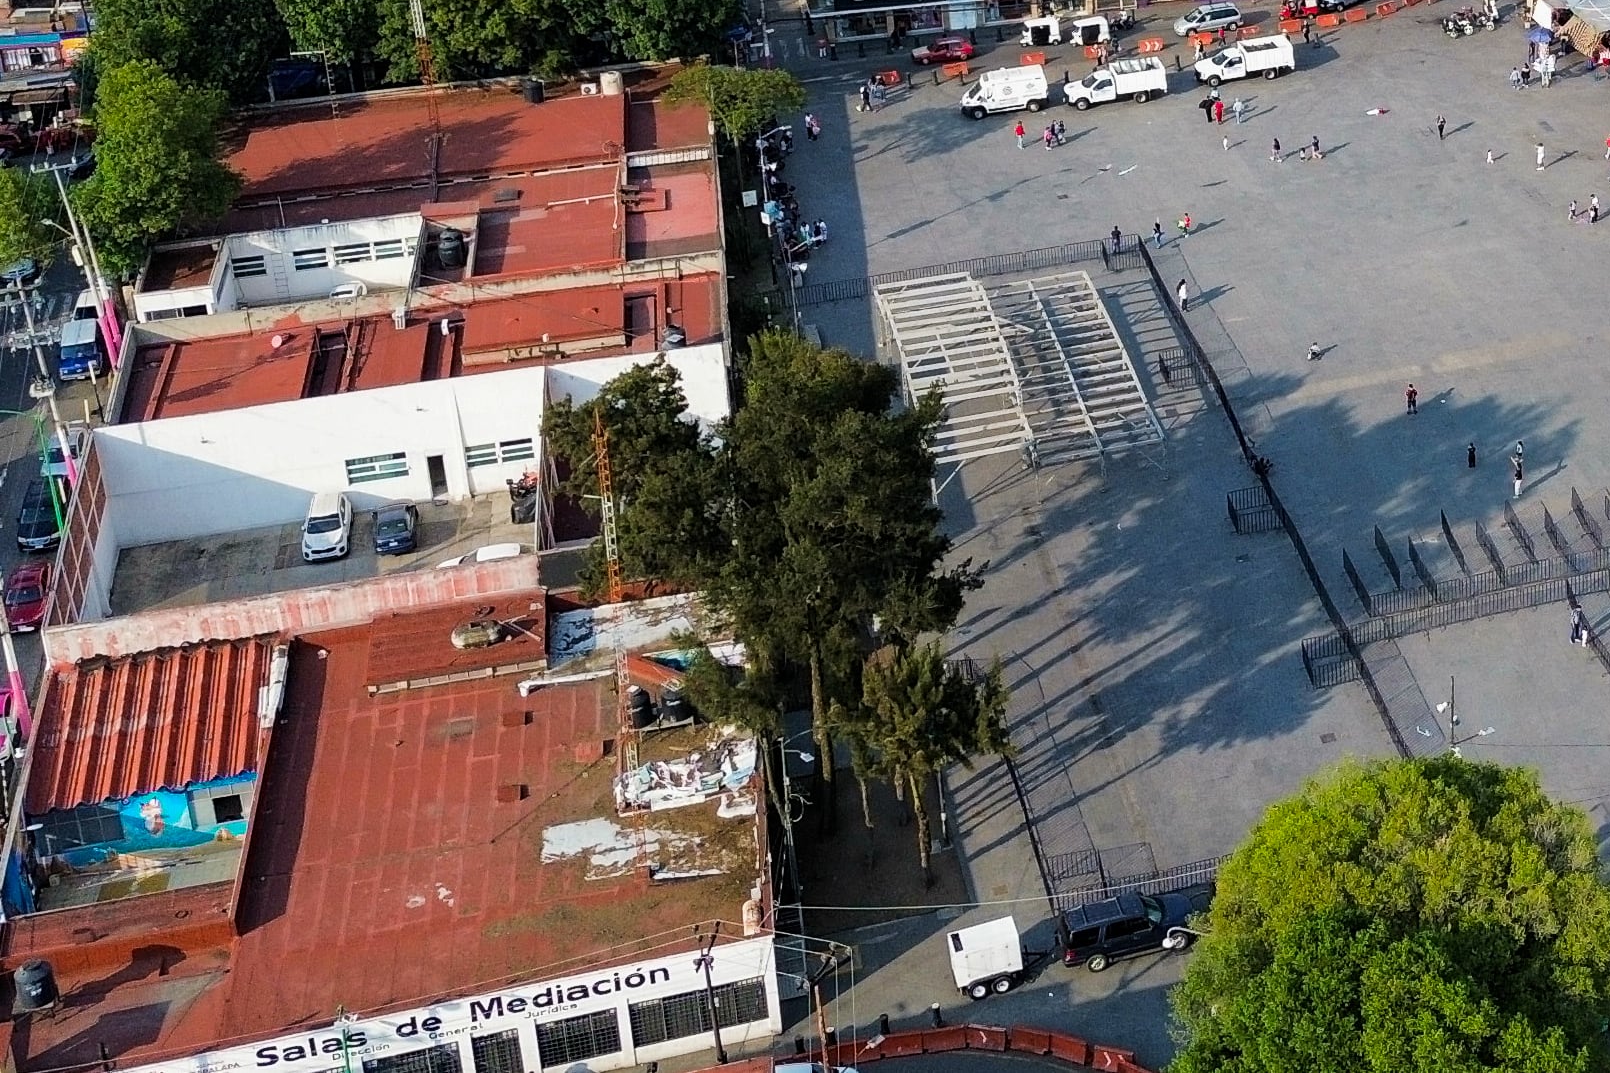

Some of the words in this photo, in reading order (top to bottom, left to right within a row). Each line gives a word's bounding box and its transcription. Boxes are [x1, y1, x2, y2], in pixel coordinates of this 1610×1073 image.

[256, 1029, 368, 1067] Salas
[395, 1015, 443, 1038] de
[470, 967, 670, 1023] Mediación
[332, 1042, 391, 1062] Dirección
[428, 1022, 484, 1040] General
[524, 1002, 578, 1020] Jurídica
